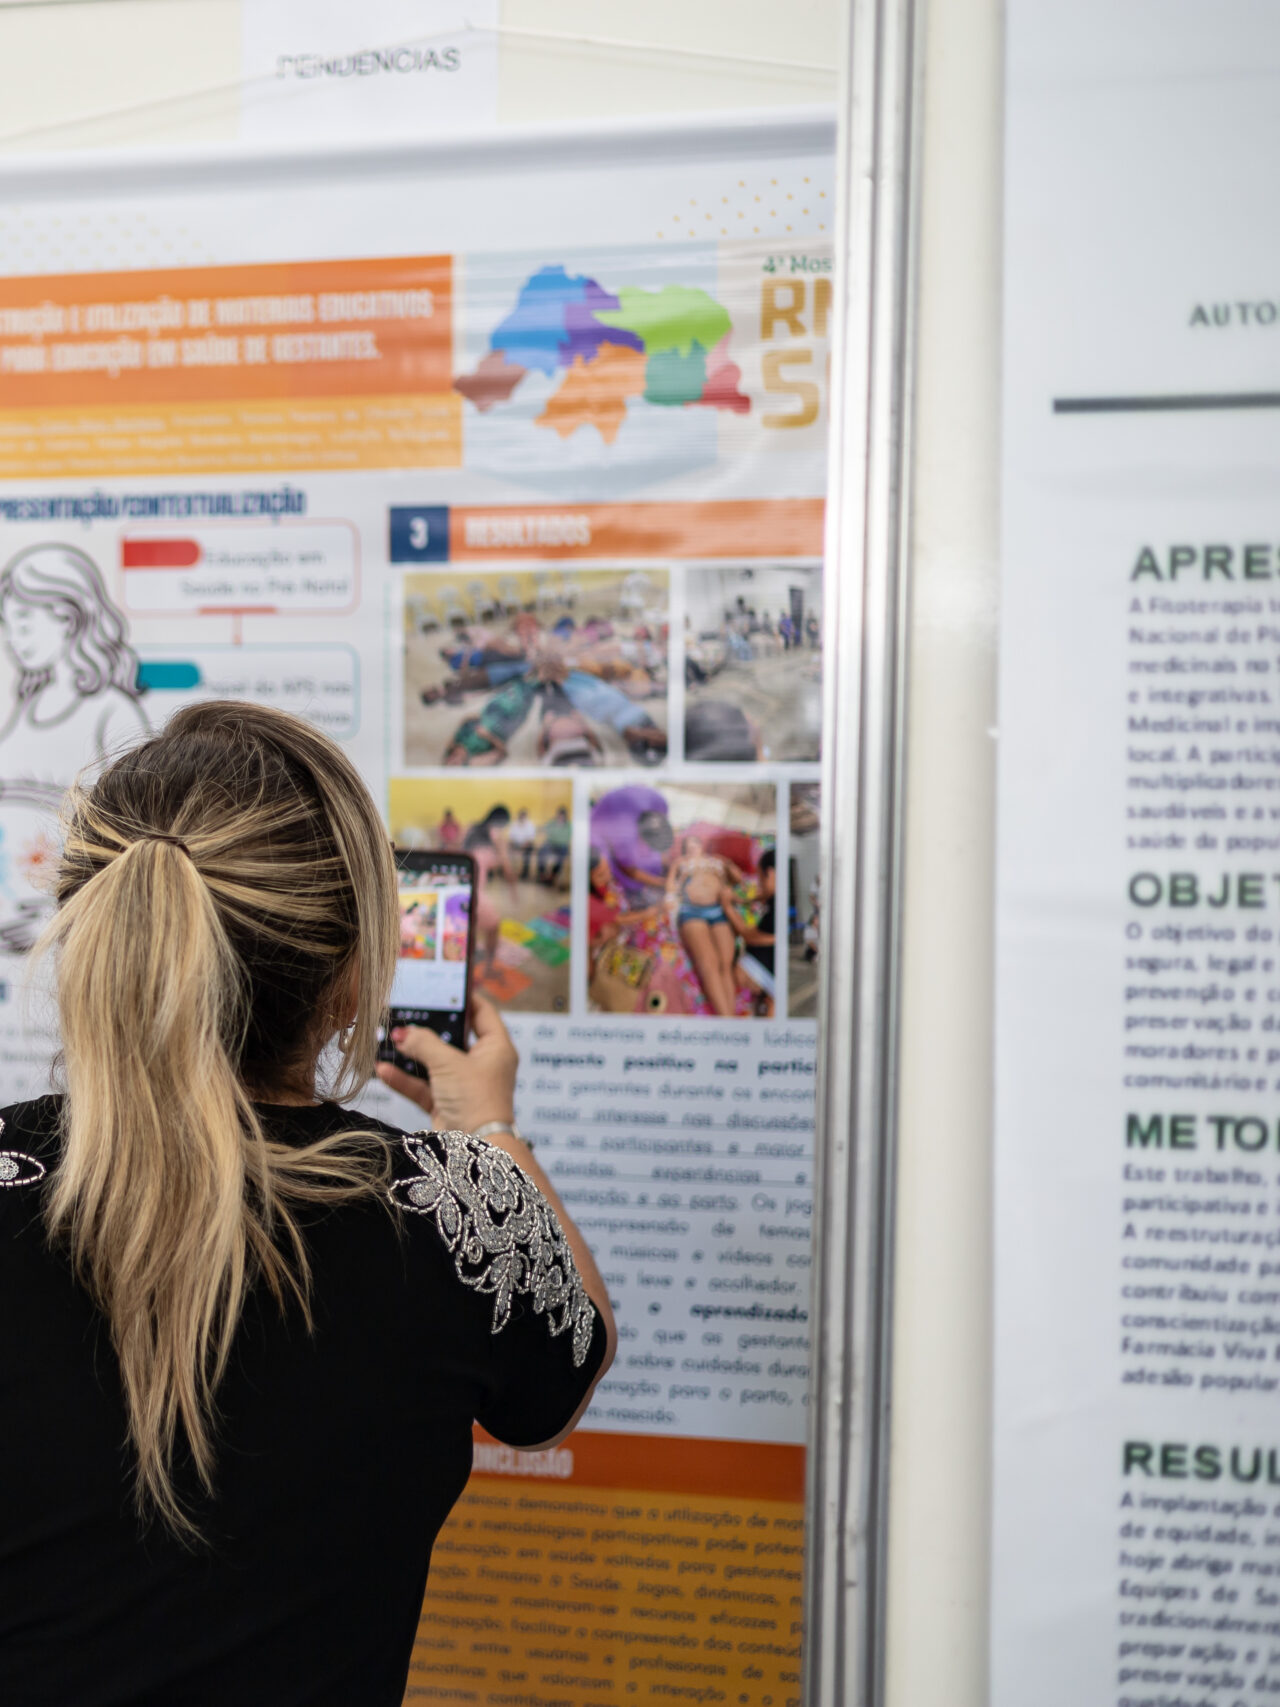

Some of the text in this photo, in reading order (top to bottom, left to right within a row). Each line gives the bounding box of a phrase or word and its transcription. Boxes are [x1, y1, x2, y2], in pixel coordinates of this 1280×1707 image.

[760, 348, 832, 429] S
[409, 505, 591, 549] 3 RESULTADOS
[1130, 545, 1280, 582] APRE
[1128, 871, 1280, 909] OBJE
[1126, 1113, 1280, 1153] METO
